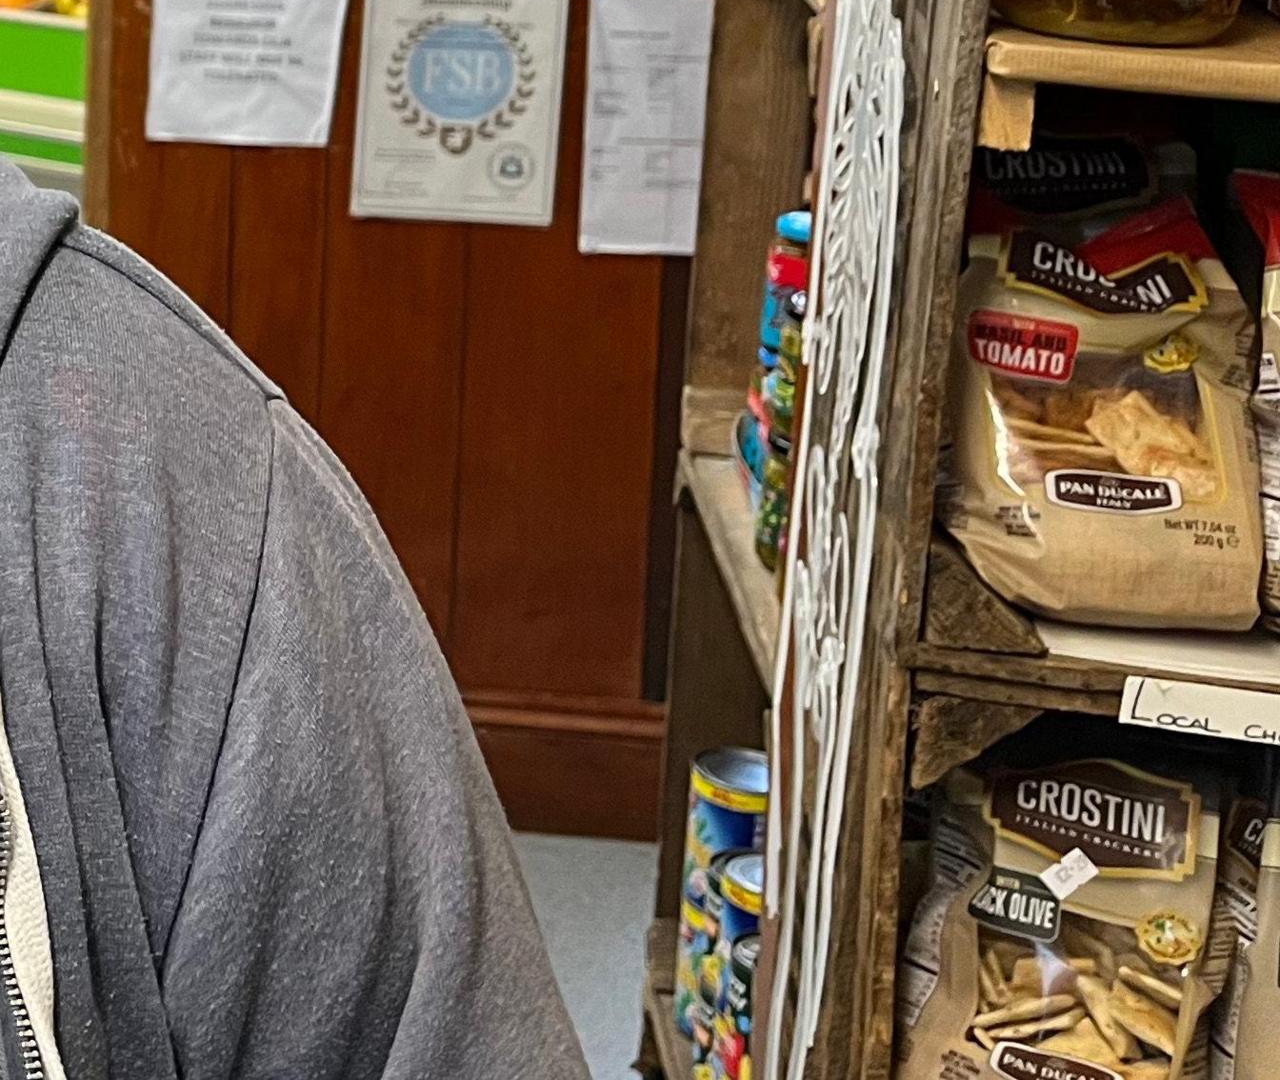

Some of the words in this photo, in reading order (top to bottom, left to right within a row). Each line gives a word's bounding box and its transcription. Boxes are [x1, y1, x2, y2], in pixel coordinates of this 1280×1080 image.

[975, 339, 1066, 376] TOMATO
[1060, 480, 1094, 497] PAN
[1098, 482, 1167, 501] DUCALE
[1130, 678, 1222, 734] LOCAL
[1016, 779, 1167, 844] CROSTINI
[1009, 892, 1056, 929] OLIVE
